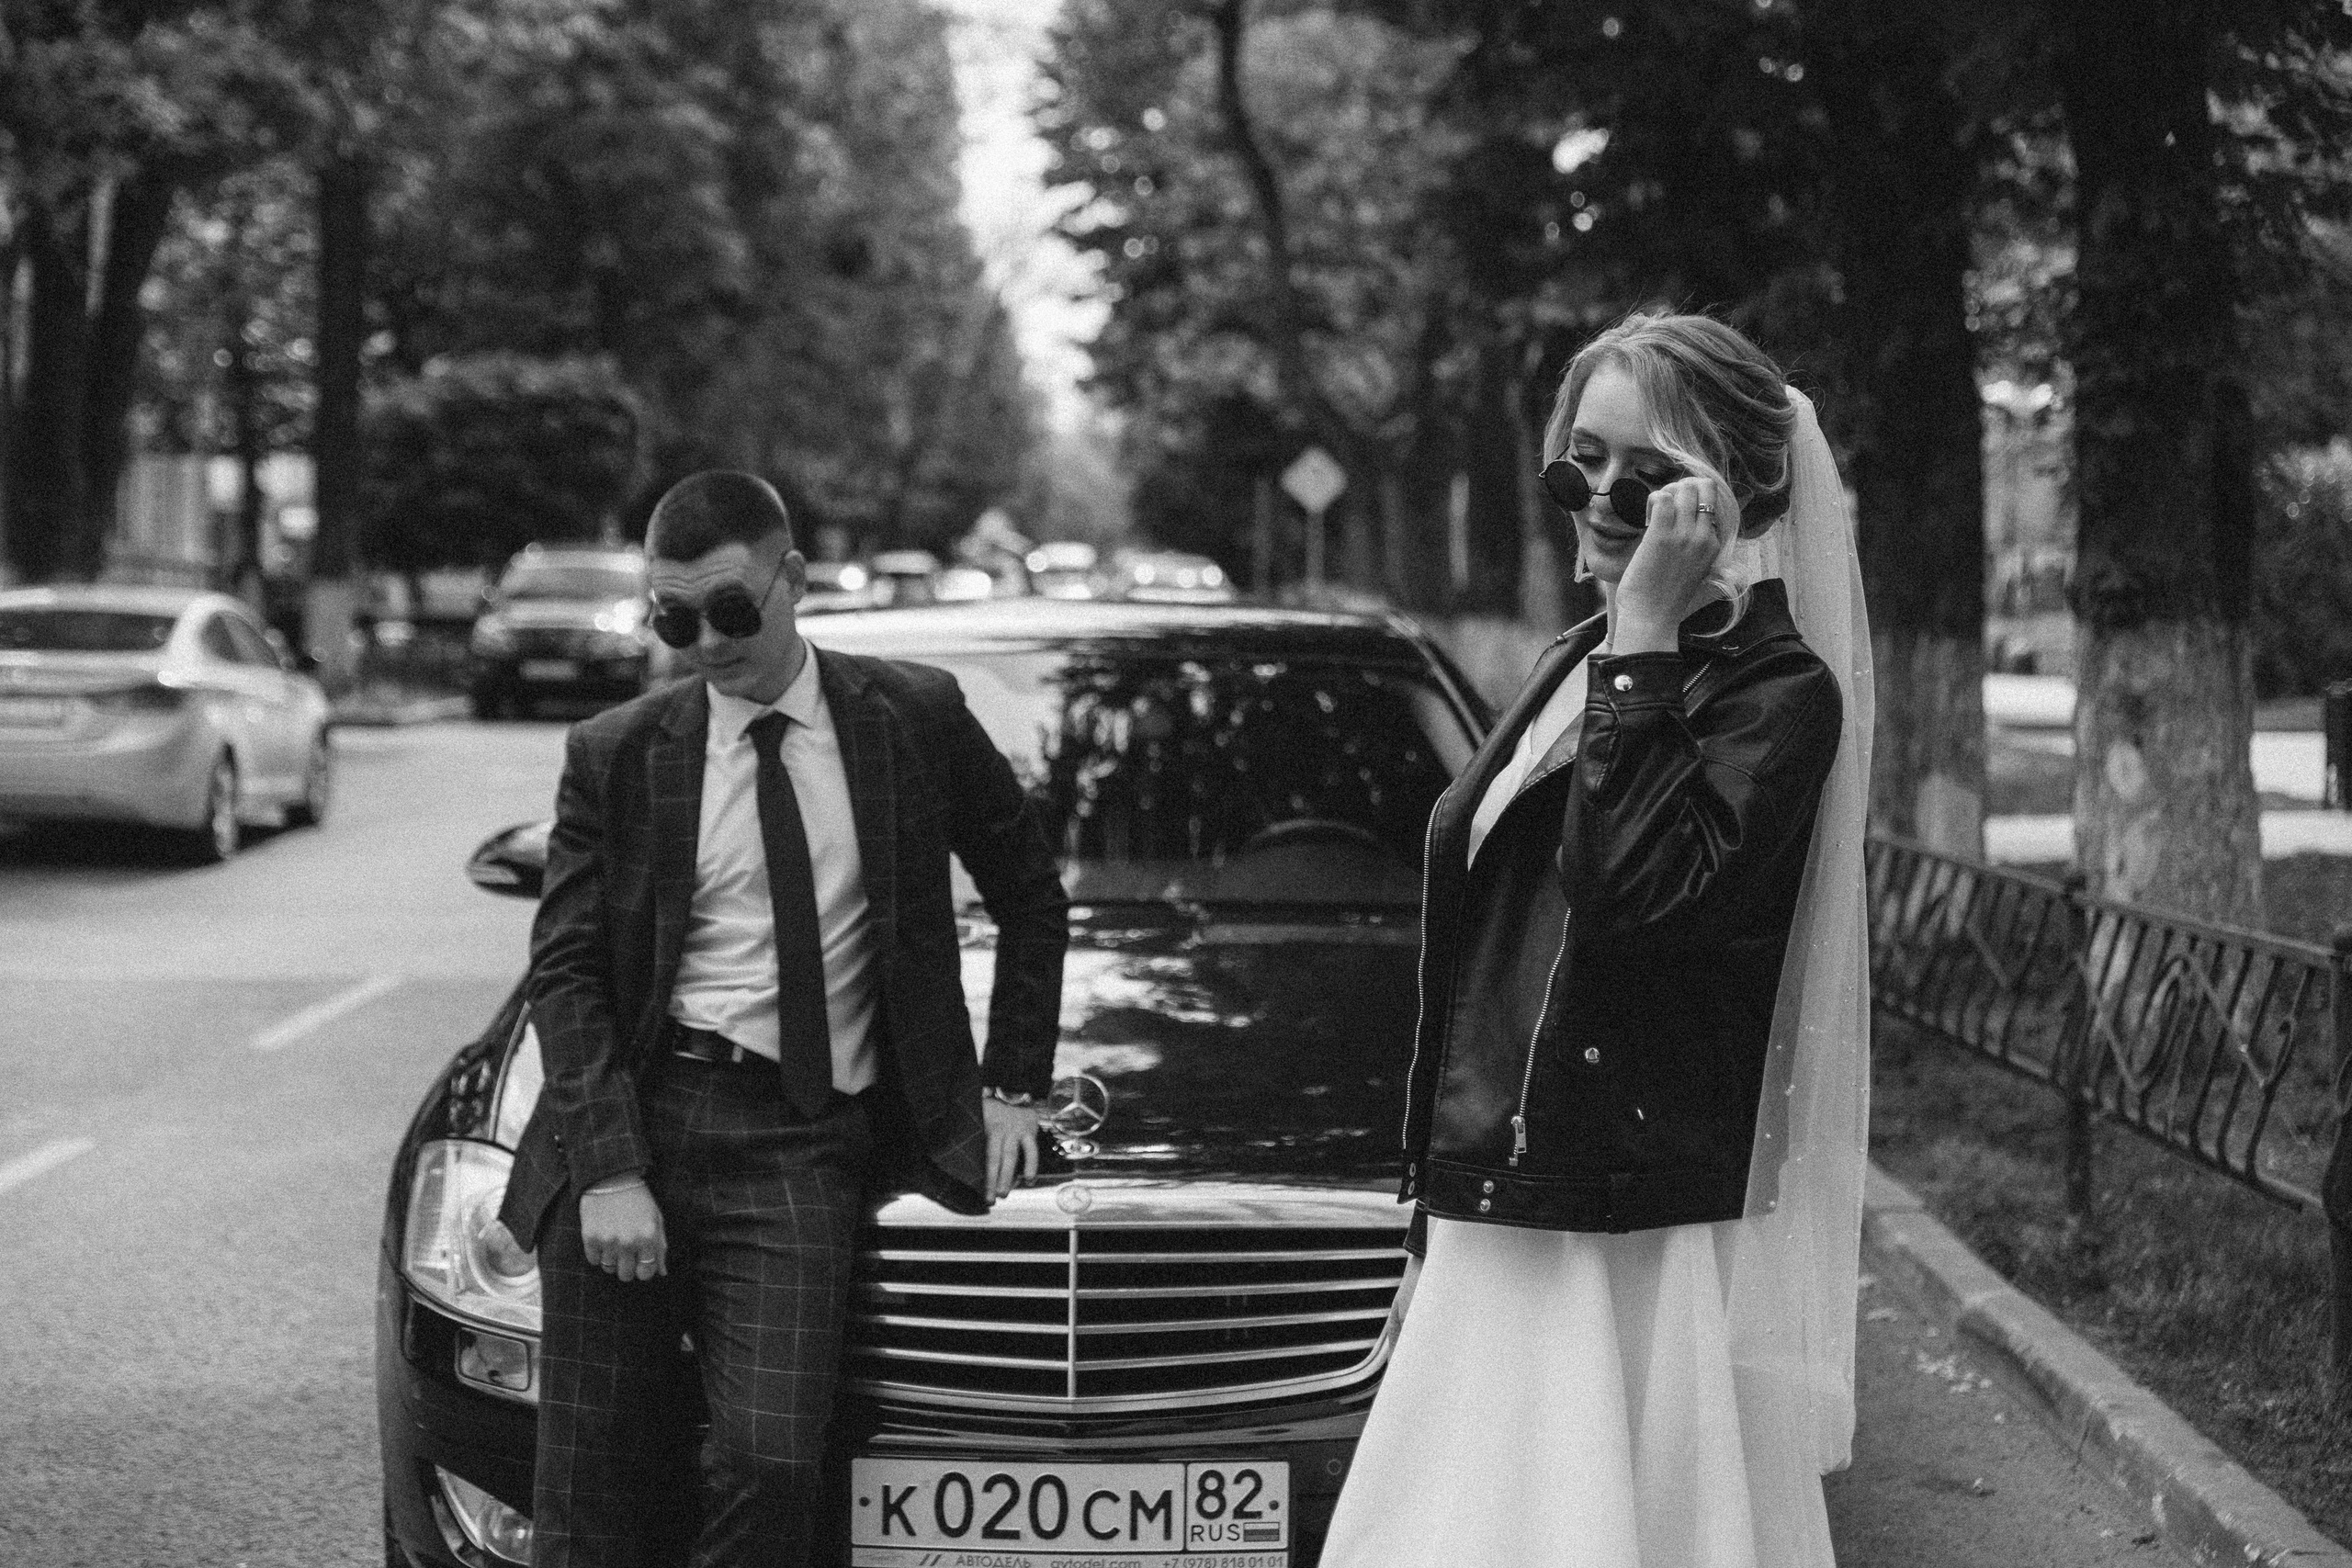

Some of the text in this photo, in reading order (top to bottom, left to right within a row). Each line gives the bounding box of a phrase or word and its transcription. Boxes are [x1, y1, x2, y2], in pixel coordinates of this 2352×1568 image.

[1196, 1469, 1262, 1519] 82
[1191, 1524, 1240, 1542] RUS
[955, 1554, 1032, 1568] АВТОДЕЛЬ
[1050, 1558, 1142, 1568] avtodelcom
